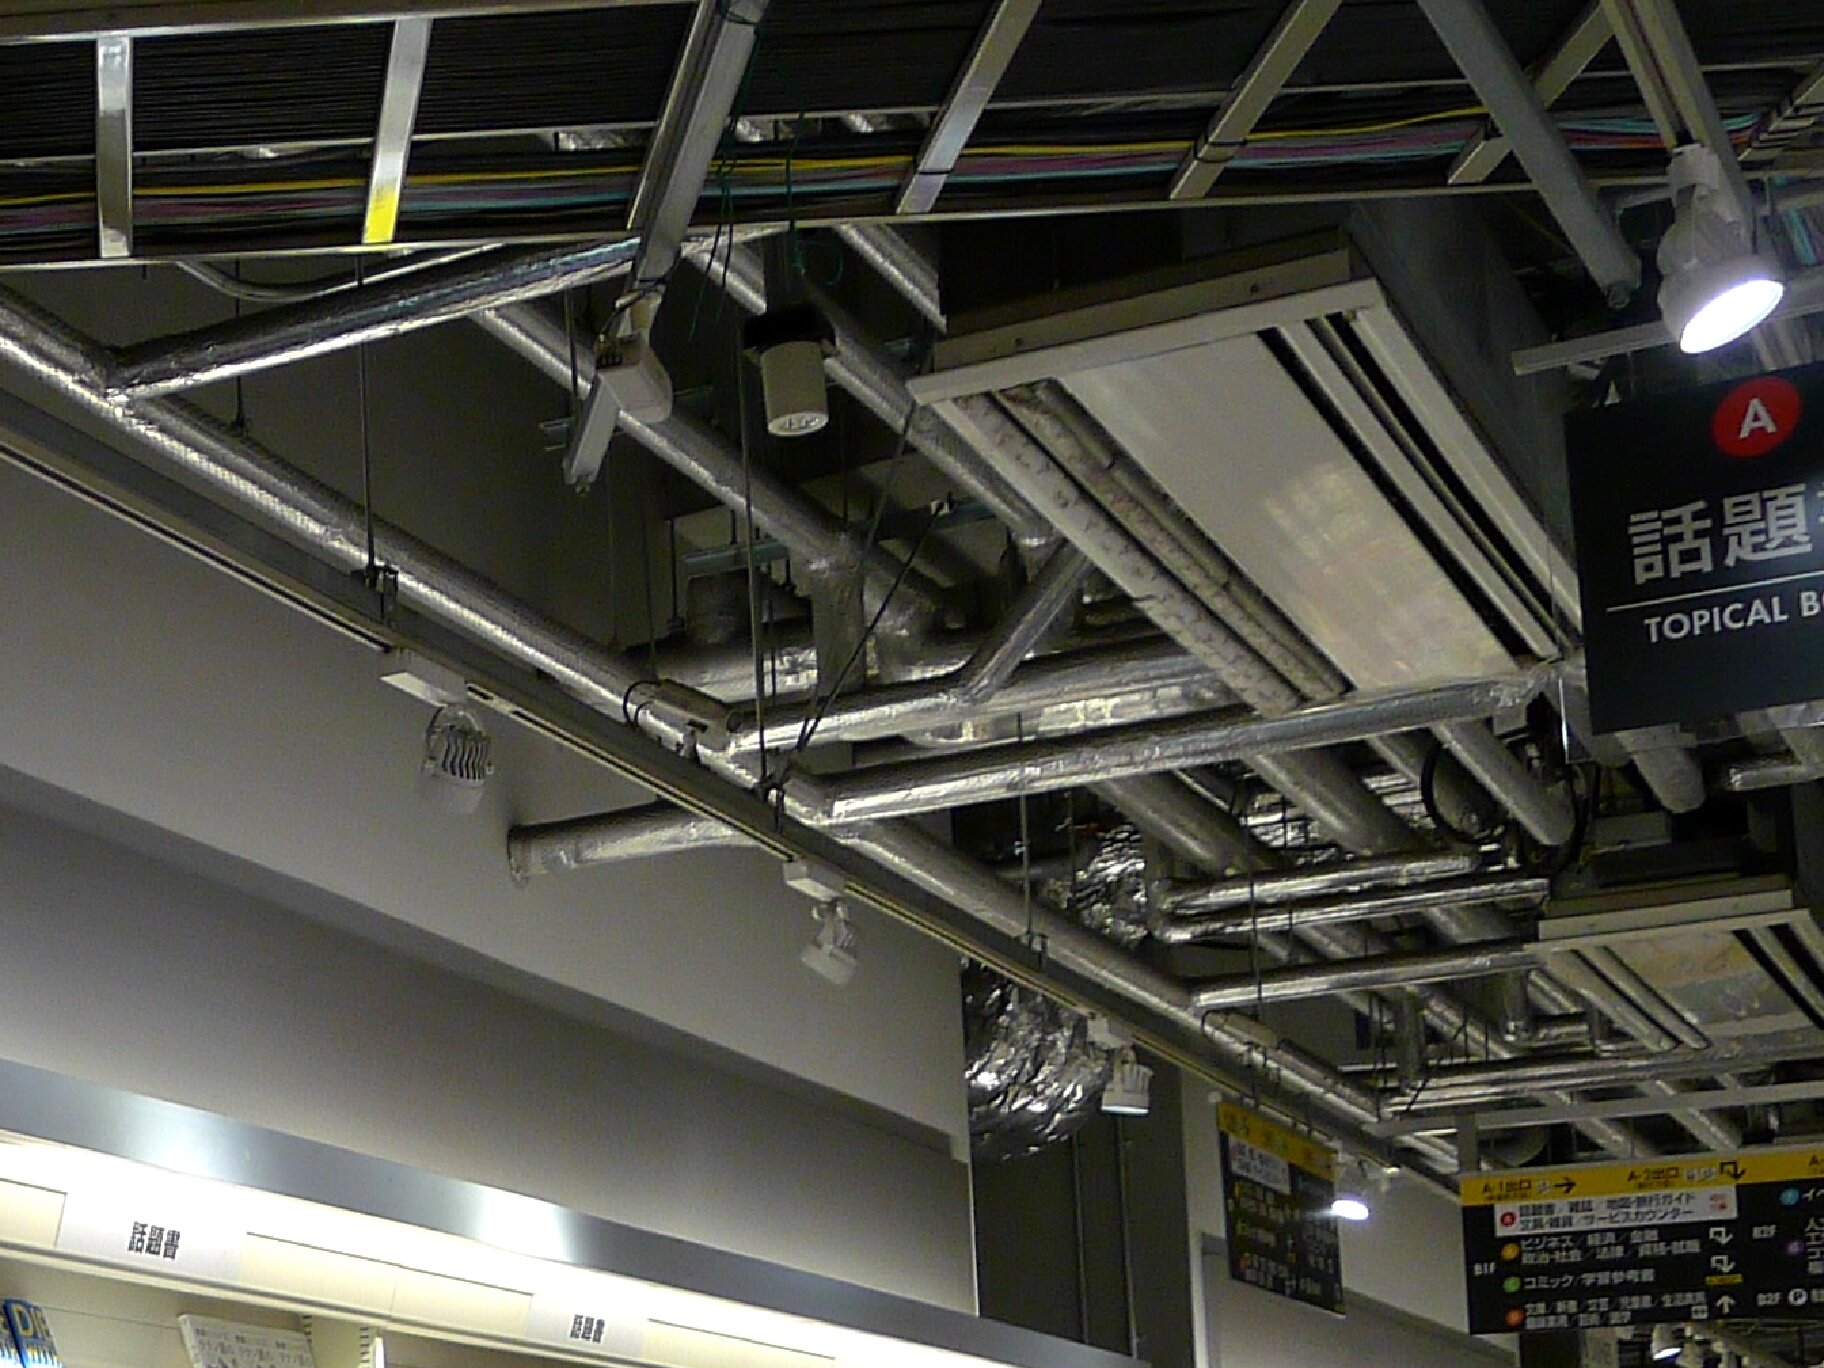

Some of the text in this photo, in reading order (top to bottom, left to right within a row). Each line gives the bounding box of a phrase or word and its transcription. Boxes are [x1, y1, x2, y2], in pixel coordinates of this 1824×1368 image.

[1739, 398, 1777, 439] A
[1628, 483, 1824, 585] 話題
[1645, 596, 1789, 643] TOPICAL
